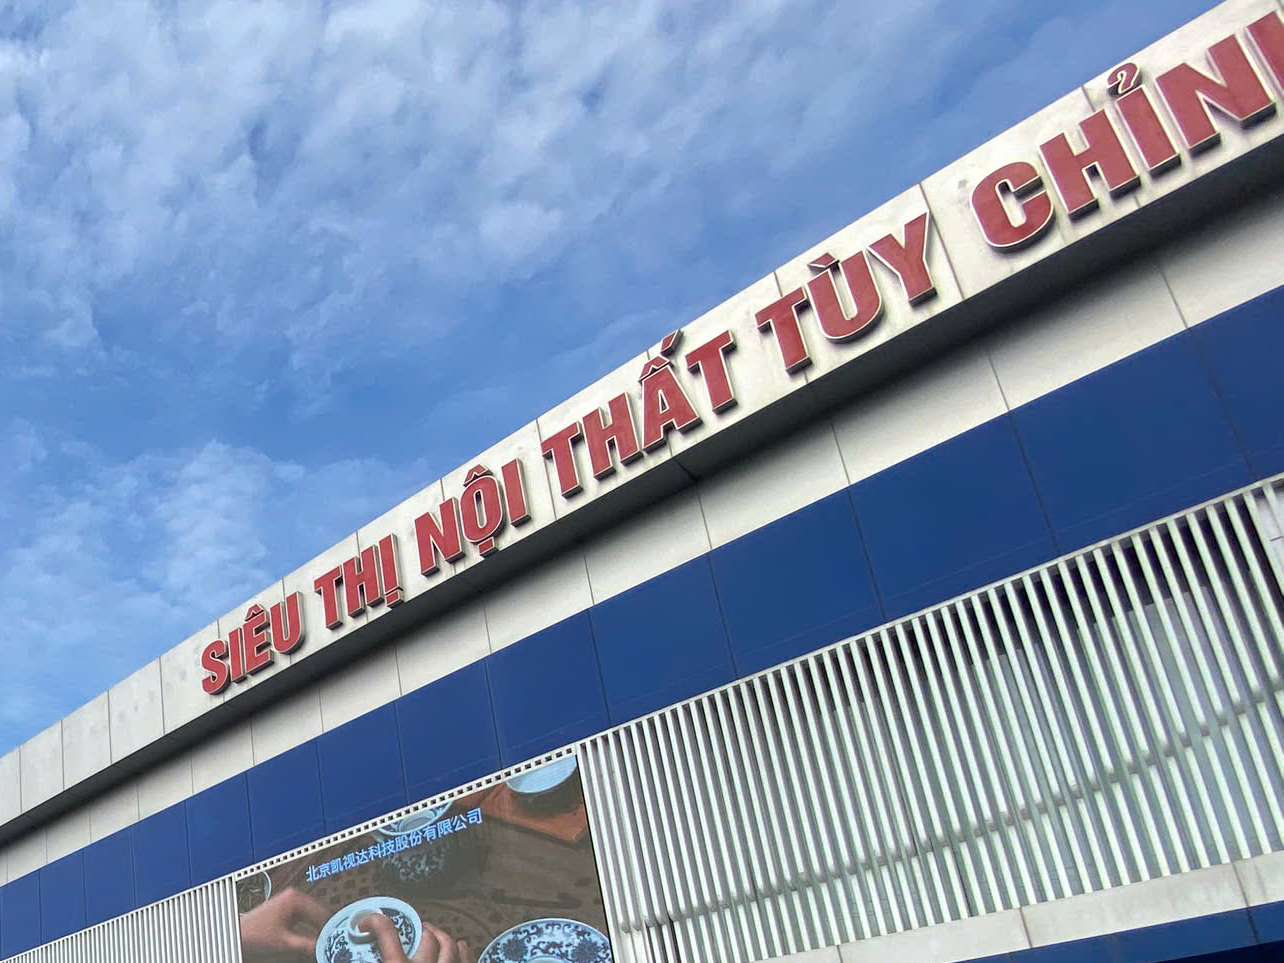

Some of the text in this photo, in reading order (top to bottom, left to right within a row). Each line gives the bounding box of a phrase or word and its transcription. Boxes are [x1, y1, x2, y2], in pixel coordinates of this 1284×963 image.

[201, 591, 303, 695] SIÊU
[314, 533, 404, 630] THỊ
[414, 458, 531, 577] NỘI
[541, 329, 737, 497] THẤT
[755, 212, 936, 375] TÙY
[305, 807, 484, 883] 北京凯视达科技股份有限公司
